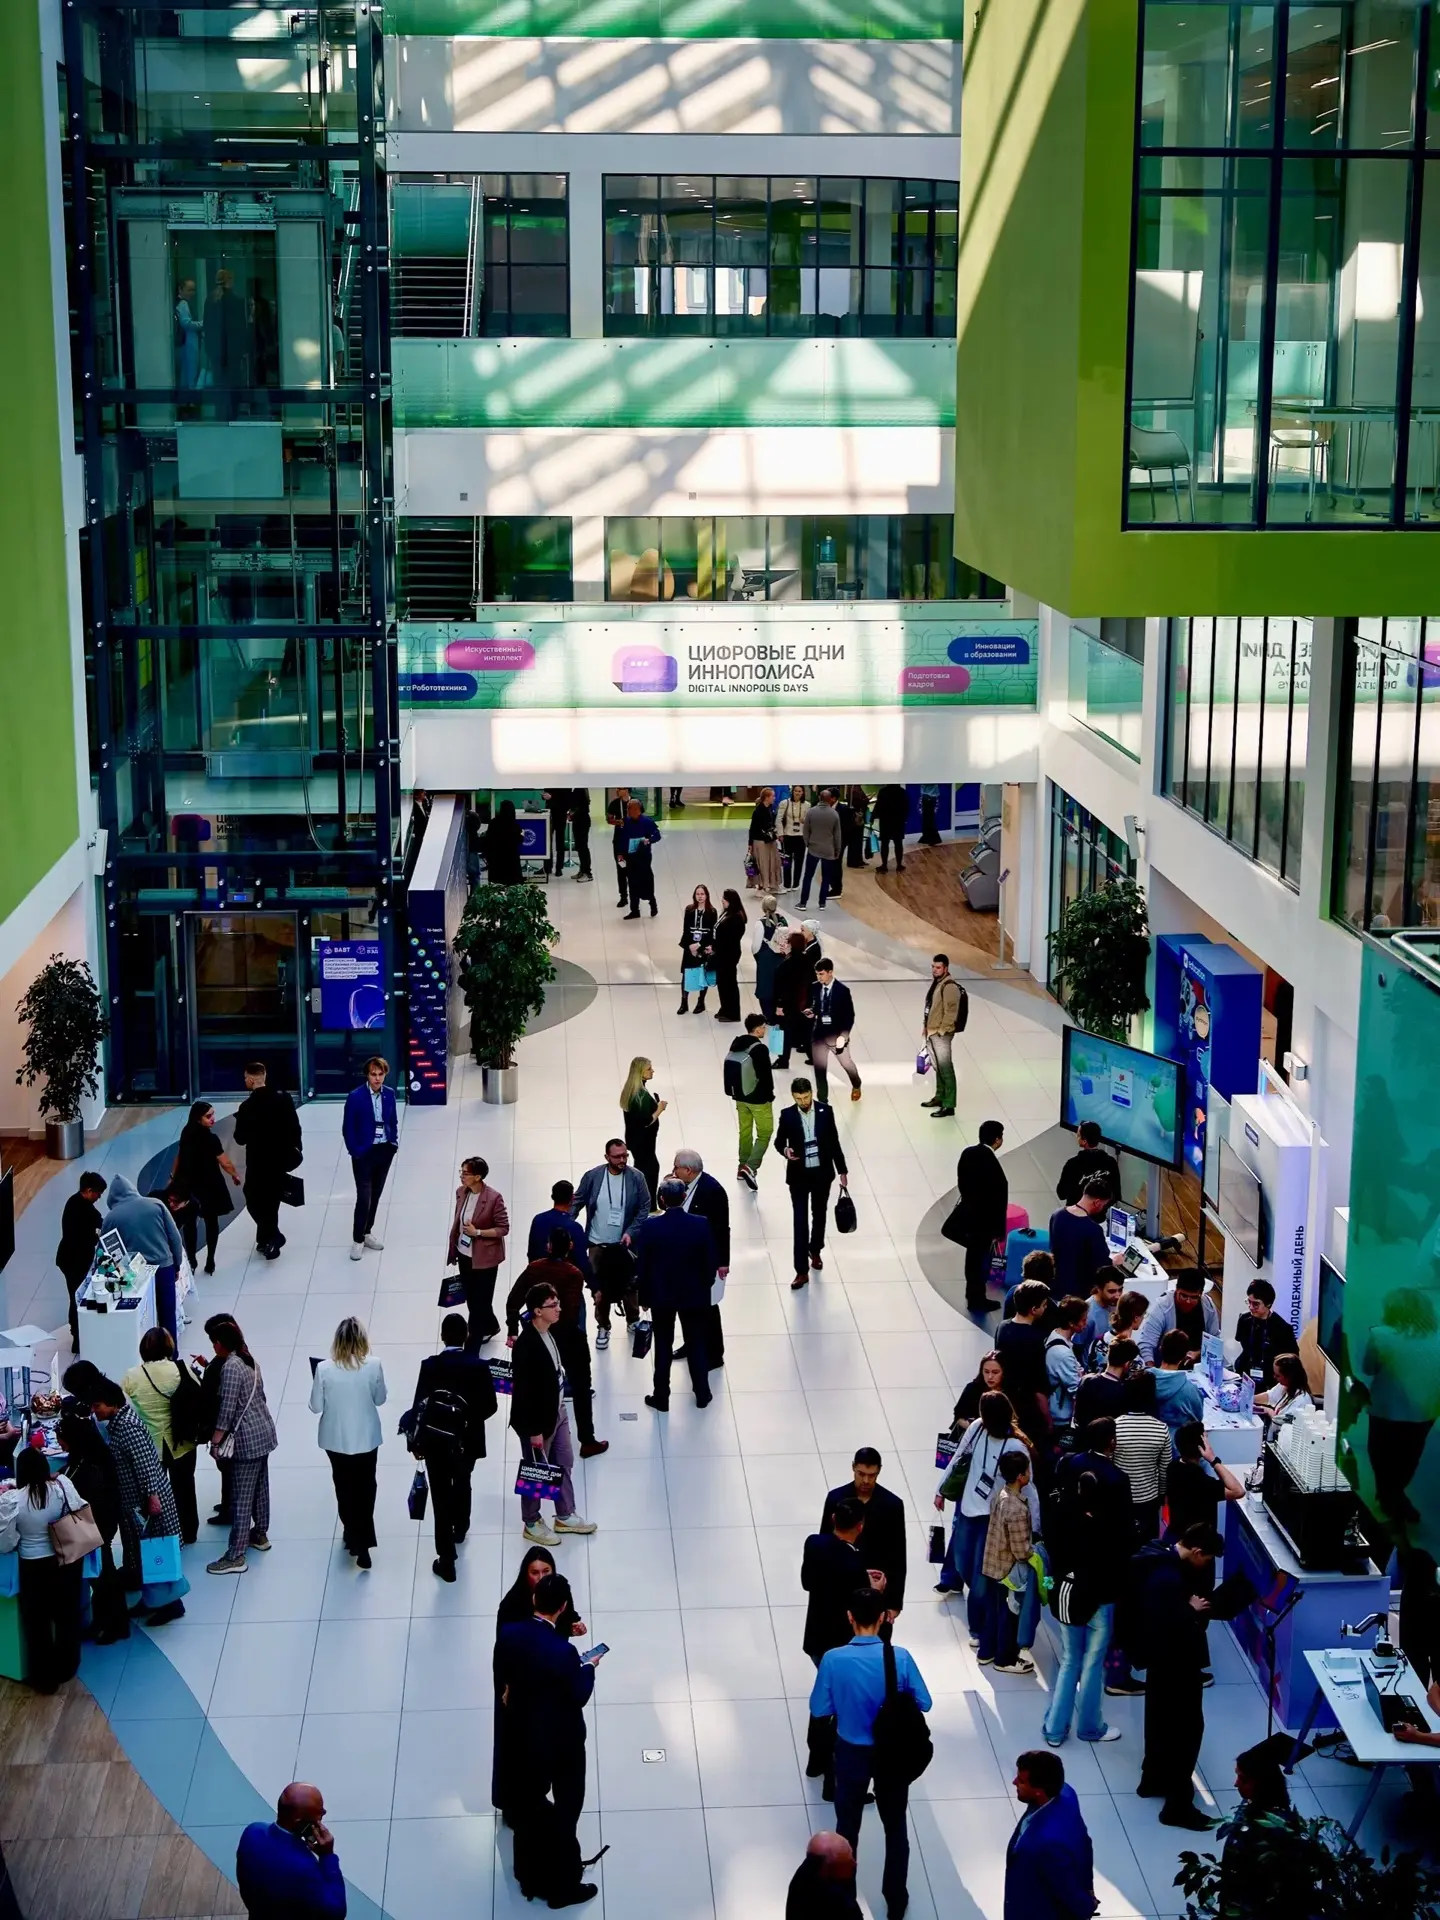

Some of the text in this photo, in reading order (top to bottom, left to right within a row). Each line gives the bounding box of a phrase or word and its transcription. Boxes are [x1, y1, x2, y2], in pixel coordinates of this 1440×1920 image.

[464, 645, 523, 655] Искусственный
[975, 643, 1016, 651] Инновации
[688, 645, 845, 661] ЦИФРОВЫЕ ДНИ
[970, 651, 1017, 659] образовании
[483, 654, 523, 662] интеллект
[688, 664, 815, 680] ИННОПОЛИСА
[908, 672, 951, 681] Подготовка
[412, 684, 468, 692] Робототехника
[688, 684, 809, 693] DIGITAL INNOPOLIS DAYS
[908, 681, 935, 689] кадров
[1294, 1225, 1304, 1256] ДЕНЬ
